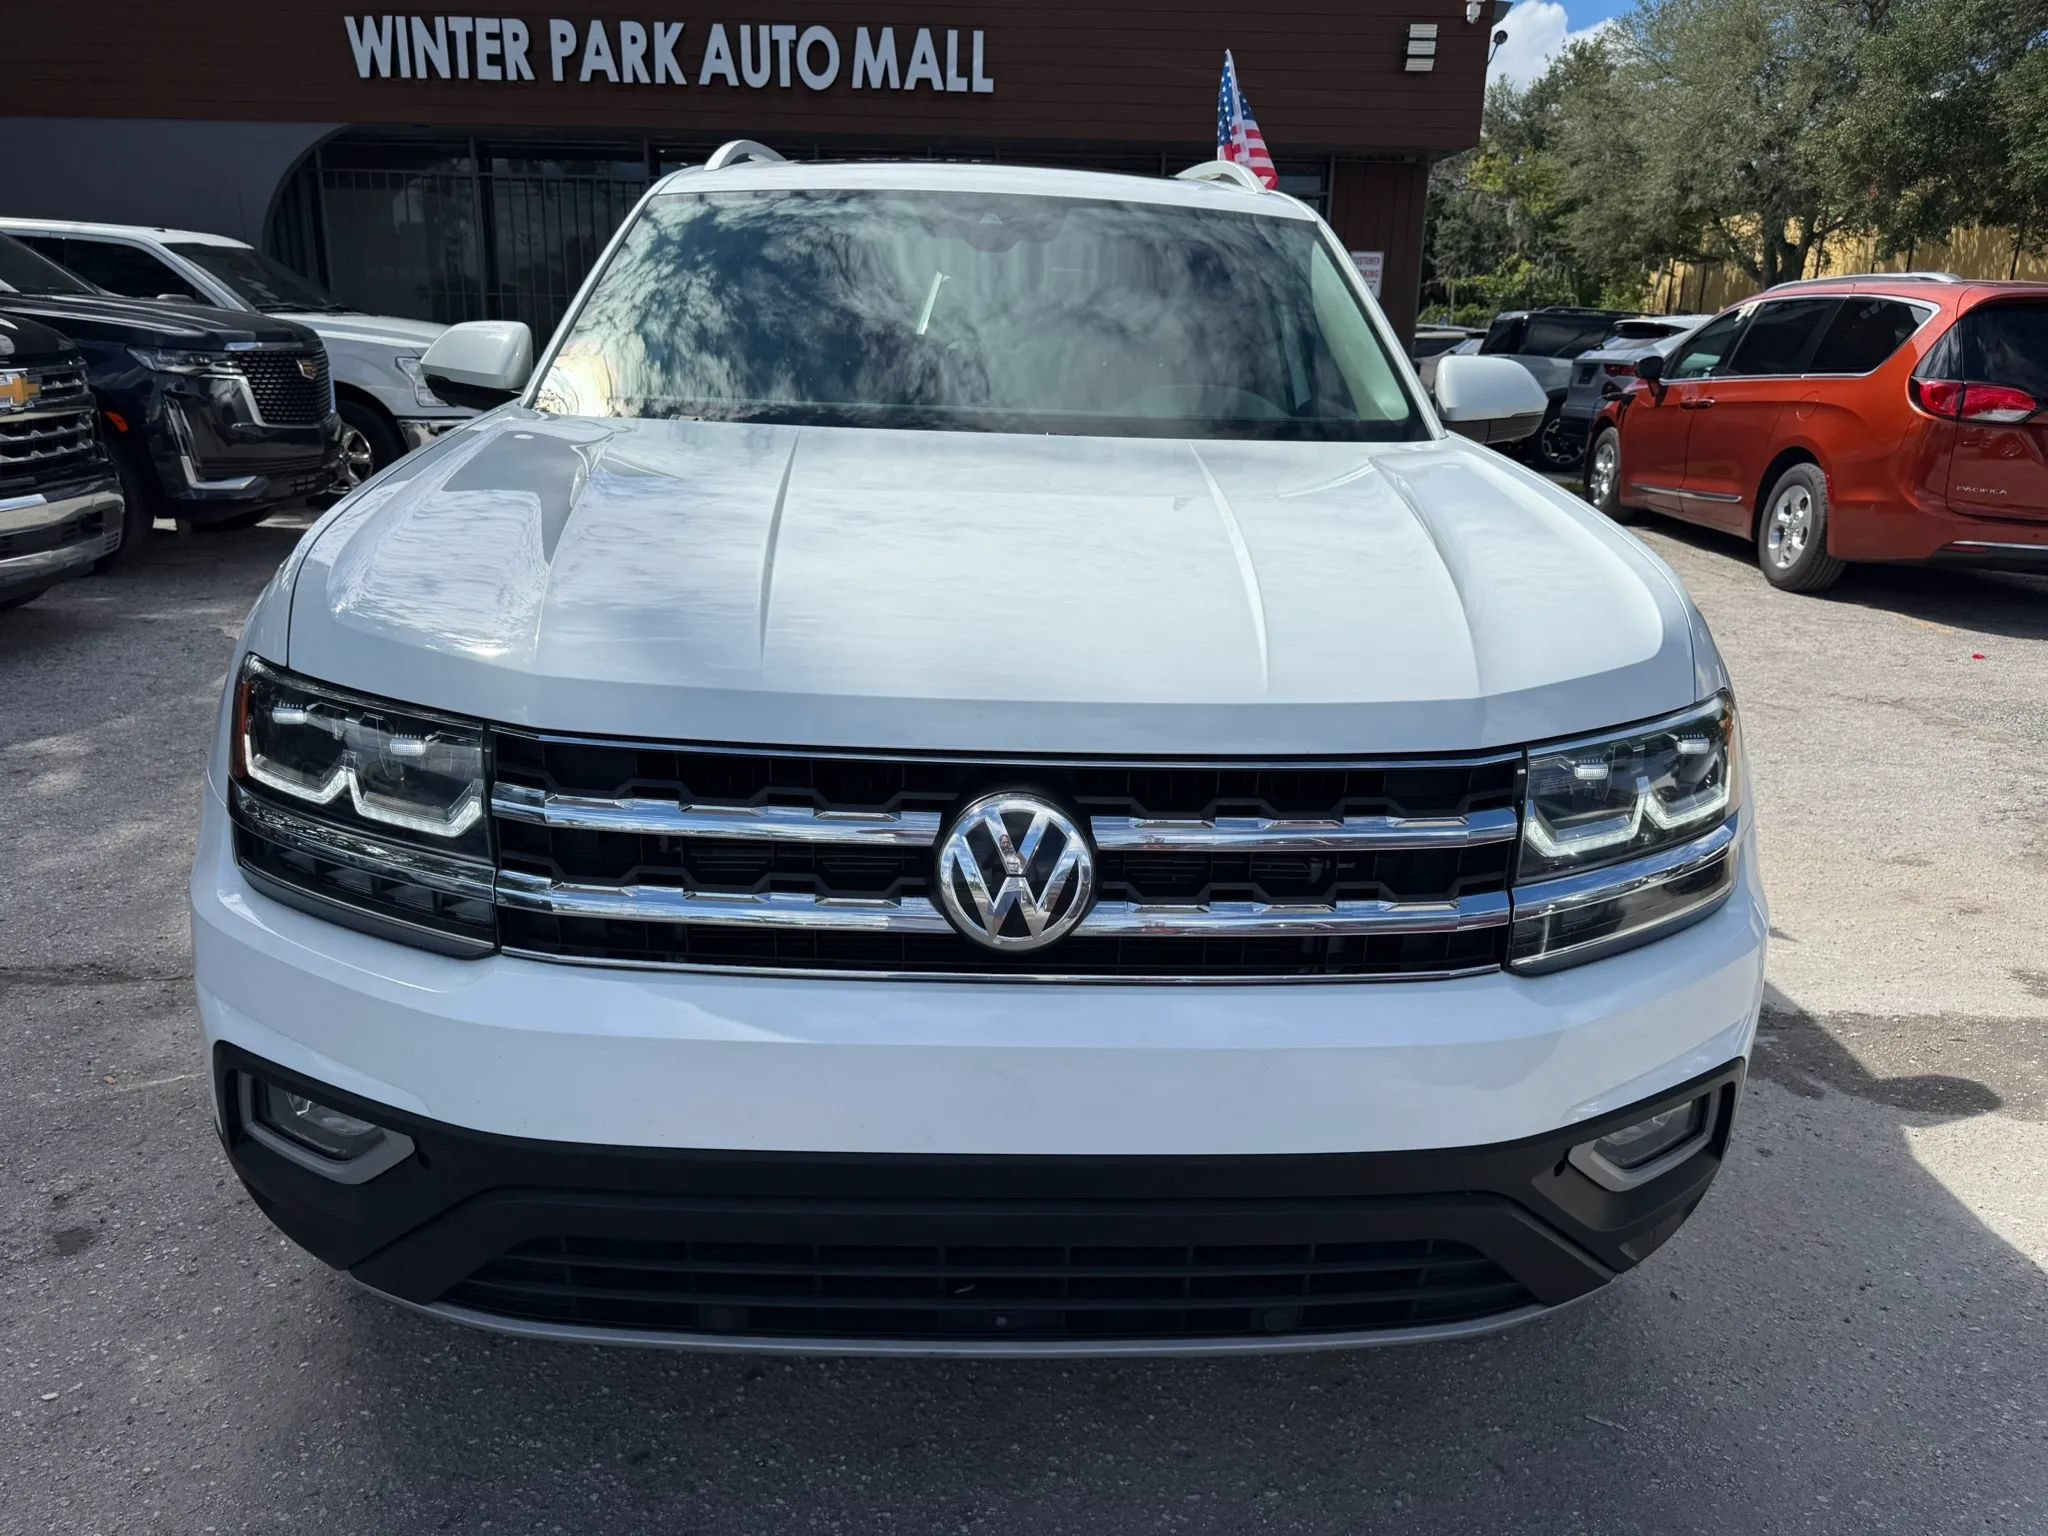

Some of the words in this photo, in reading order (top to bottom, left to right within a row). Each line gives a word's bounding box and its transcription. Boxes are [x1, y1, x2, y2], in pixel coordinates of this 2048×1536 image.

[344, 15, 535, 81] WINTER
[549, 18, 688, 85] PARK
[698, 23, 840, 91] AUTO
[851, 26, 994, 93] MALL
[1956, 485, 2007, 495] PACIFICA
[940, 791, 1093, 950] VW
